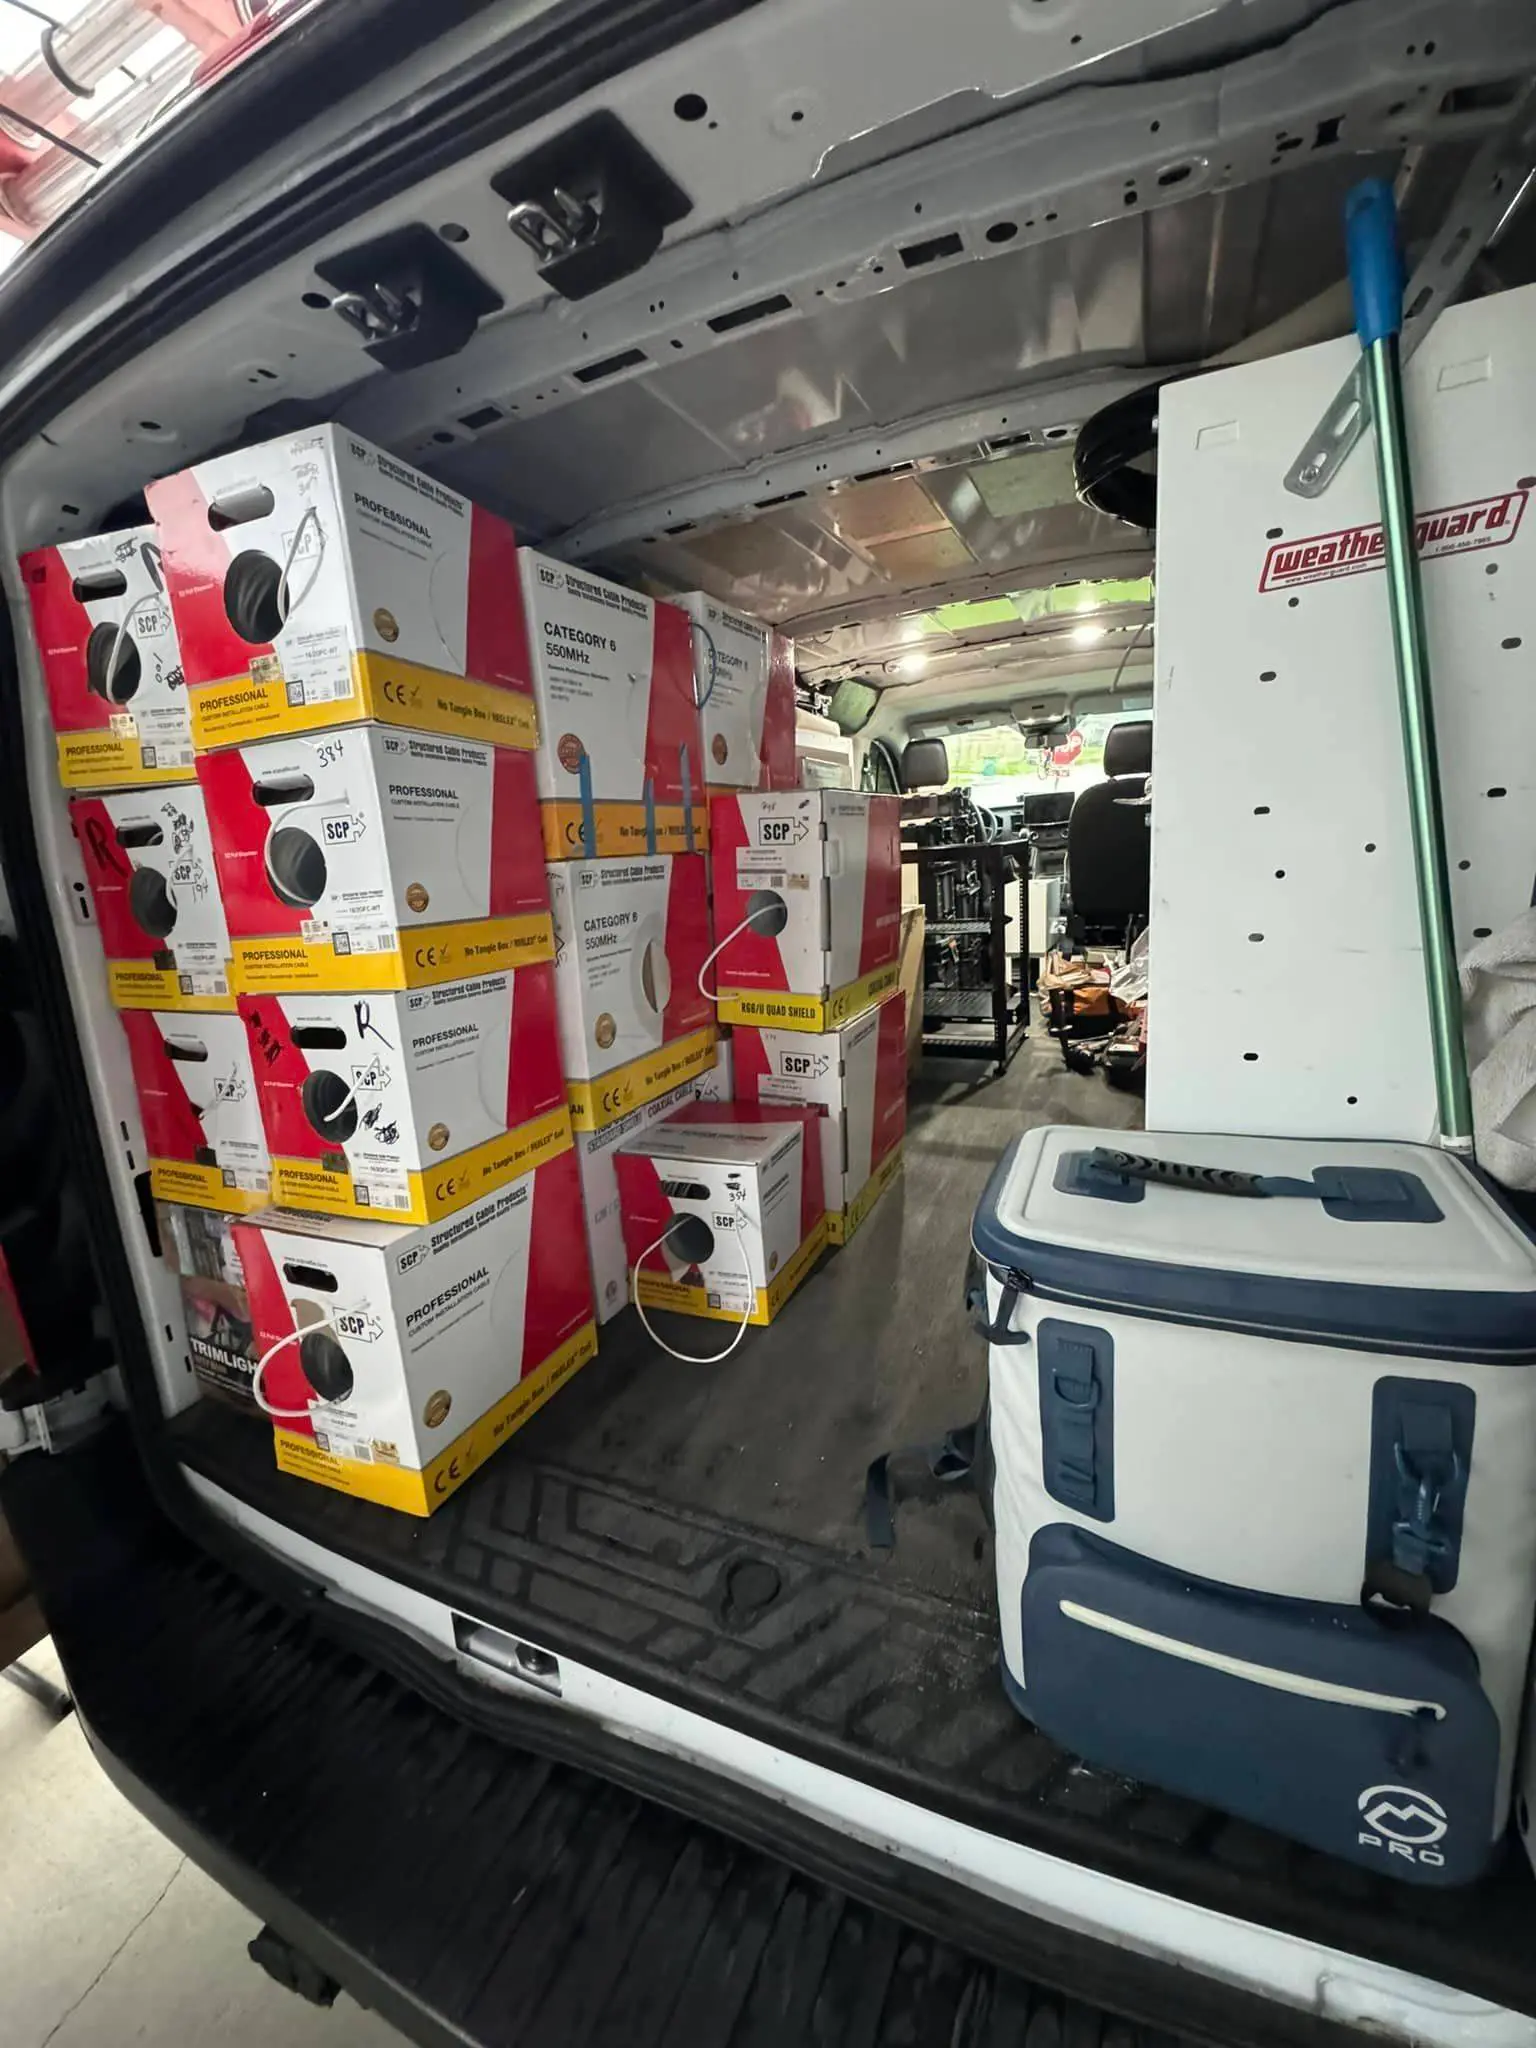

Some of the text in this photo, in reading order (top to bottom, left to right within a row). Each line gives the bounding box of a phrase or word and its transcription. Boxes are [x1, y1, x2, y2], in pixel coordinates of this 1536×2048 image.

[353, 492, 431, 539] PROFESSIONAL
[1272, 531, 1386, 575] weathe
[138, 615, 158, 634] SCP
[544, 621, 617, 651] CATEGORY 6
[546, 642, 590, 665] 550MHz
[199, 687, 269, 712] PROFESSIONAL
[66, 743, 125, 759] PROFESSIONAL
[389, 784, 460, 799] PROFESSIONAL
[326, 820, 350, 840] SCP
[763, 823, 790, 841] SCP
[584, 911, 638, 932] CATEGORY 6
[585, 934, 617, 951] 550MHz
[242, 949, 309, 961] PROFESSIONAL
[765, 1004, 787, 1017] QUAD
[787, 1006, 816, 1019] SHIELD
[412, 1023, 479, 1049] PROFESSIONAL
[785, 1058, 811, 1074] SCP
[279, 1169, 338, 1185] PROFESSIONAL
[400, 1184, 527, 1270] SCP Structured Cable Products
[715, 1216, 735, 1228] SCP
[405, 1266, 490, 1327] PROFESSIONAL
[338, 1316, 365, 1336] SCP
[190, 1337, 258, 1376] TRIMLIGH
[280, 1440, 341, 1466] PROFESSIONAL
[1358, 1831, 1445, 1867] PRO
